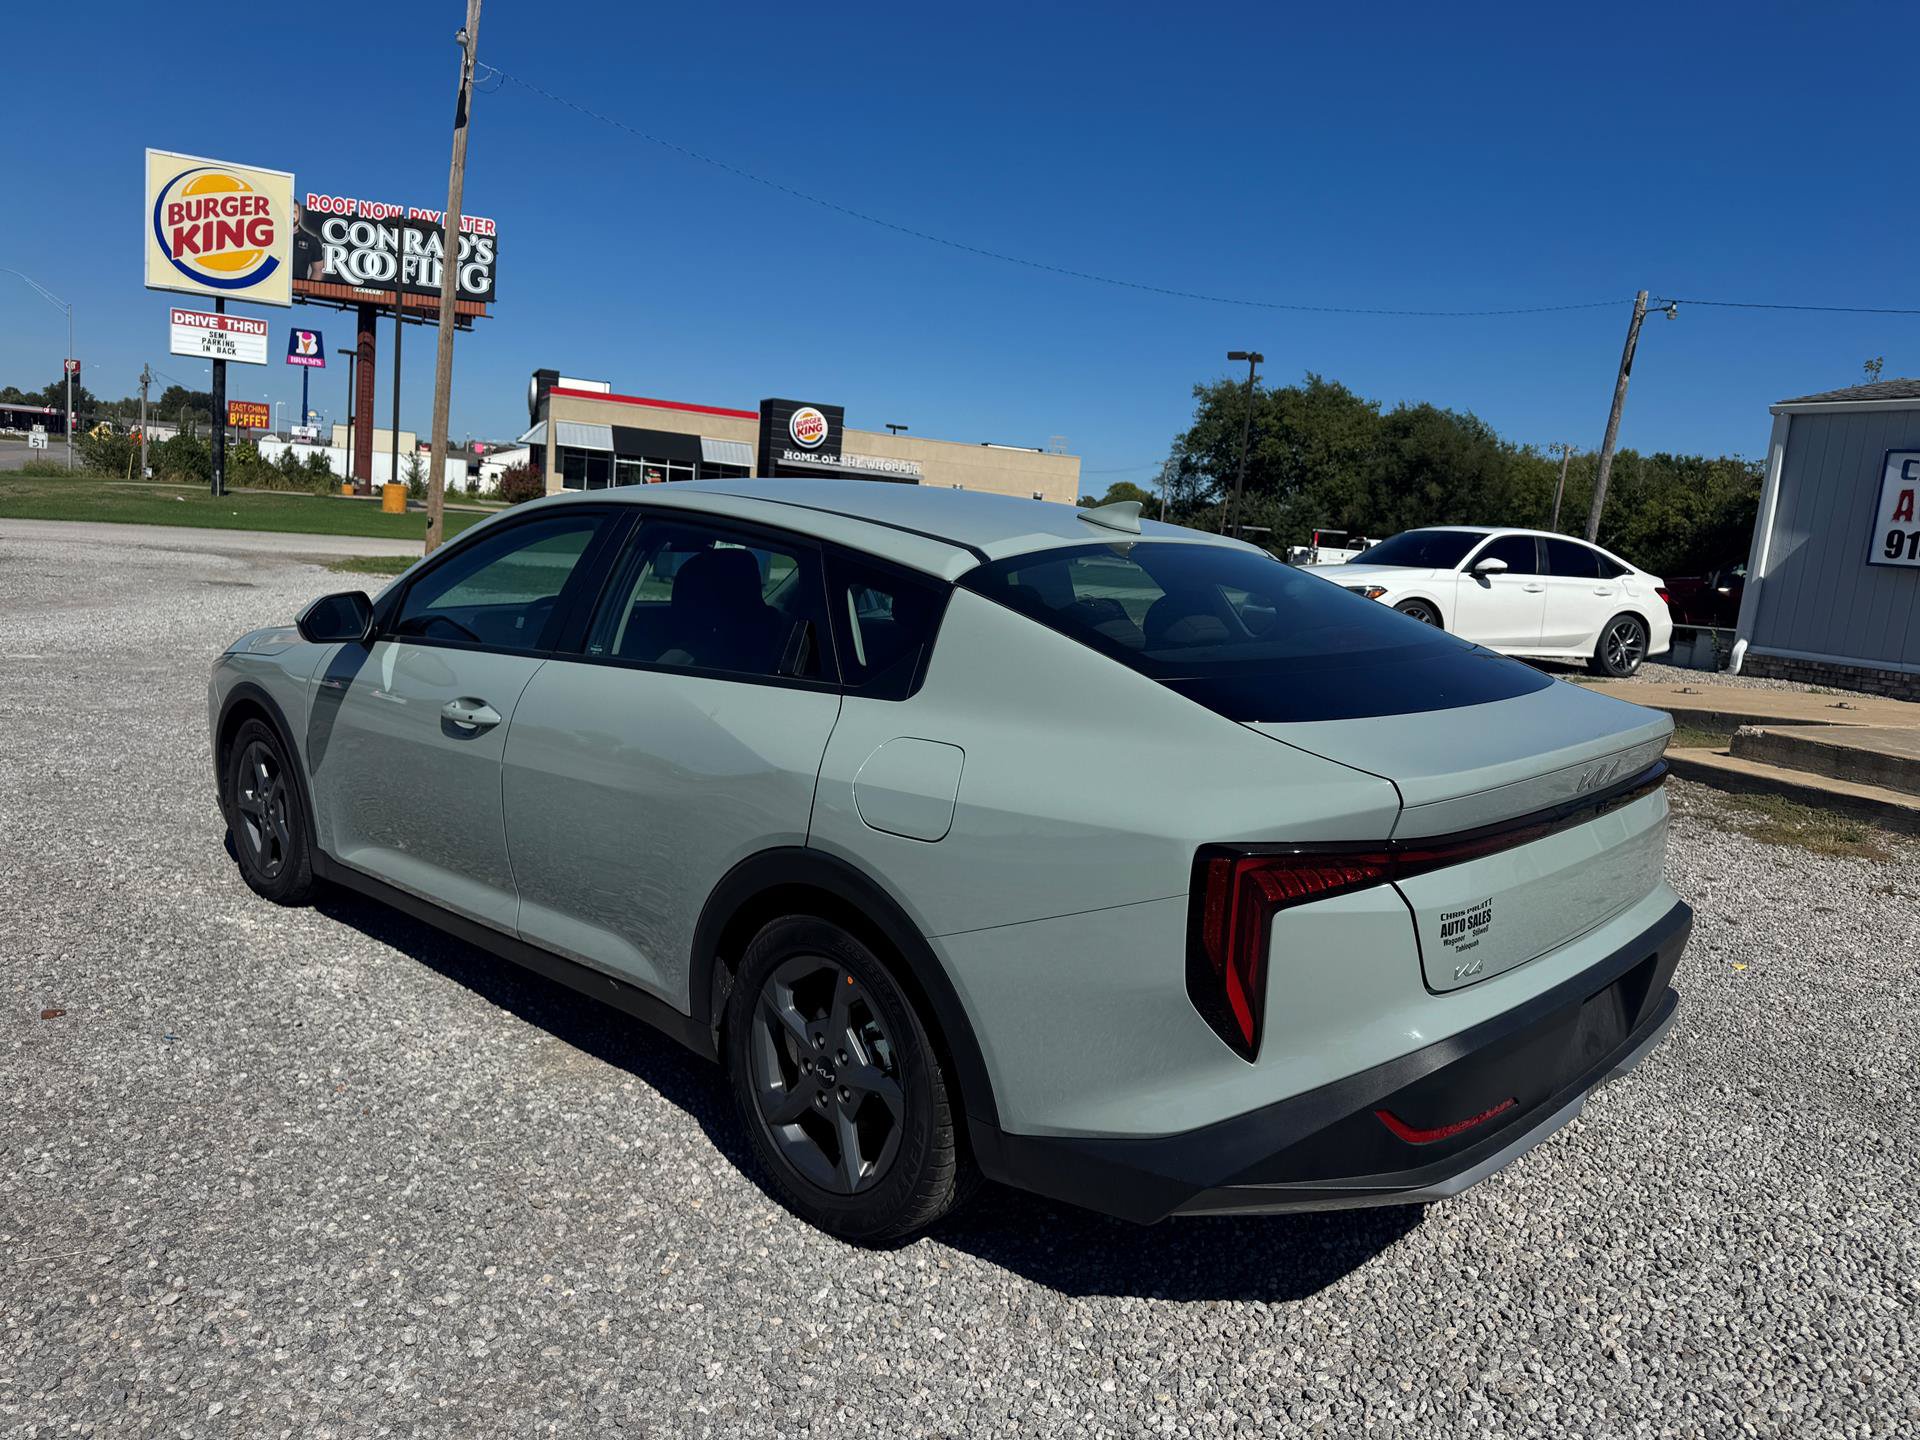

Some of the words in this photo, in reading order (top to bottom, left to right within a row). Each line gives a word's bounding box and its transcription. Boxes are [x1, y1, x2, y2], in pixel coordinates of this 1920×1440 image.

[168, 196, 270, 226] BURGER
[307, 193, 357, 217] ROOF
[409, 207, 440, 224] PAY
[172, 217, 274, 259] KING
[322, 218, 494, 265] CONRAD'S
[174, 313, 218, 328] DRIVE
[224, 319, 265, 334] THRU
[201, 337, 235, 348] PARKING
[208, 331, 228, 340] SEMI
[217, 347, 237, 356] BACK
[230, 402, 248, 412] EAST
[248, 404, 269, 414] CHINA
[230, 412, 268, 428] BUFFET
[796, 417, 822, 428] BURGER
[797, 423, 823, 438] KING
[33, 439, 45, 448] 51
[784, 450, 819, 464] HOME
[822, 454, 837, 465] OF
[840, 456, 864, 468] THE
[866, 459, 922, 475] WHOPPER
[1901, 458, 1920, 480] C
[1891, 489, 1920, 522] A
[1884, 530, 1920, 559] 91
[1441, 910, 1466, 922] CHRIS
[1467, 897, 1493, 915] PRUITT
[1440, 918, 1466, 939] AUTO
[1467, 909, 1492, 931] SALES
[1443, 935, 1466, 948] Wagoner
[1472, 924, 1489, 937] Stilwell
[1456, 939, 1479, 953] Tahlequah
